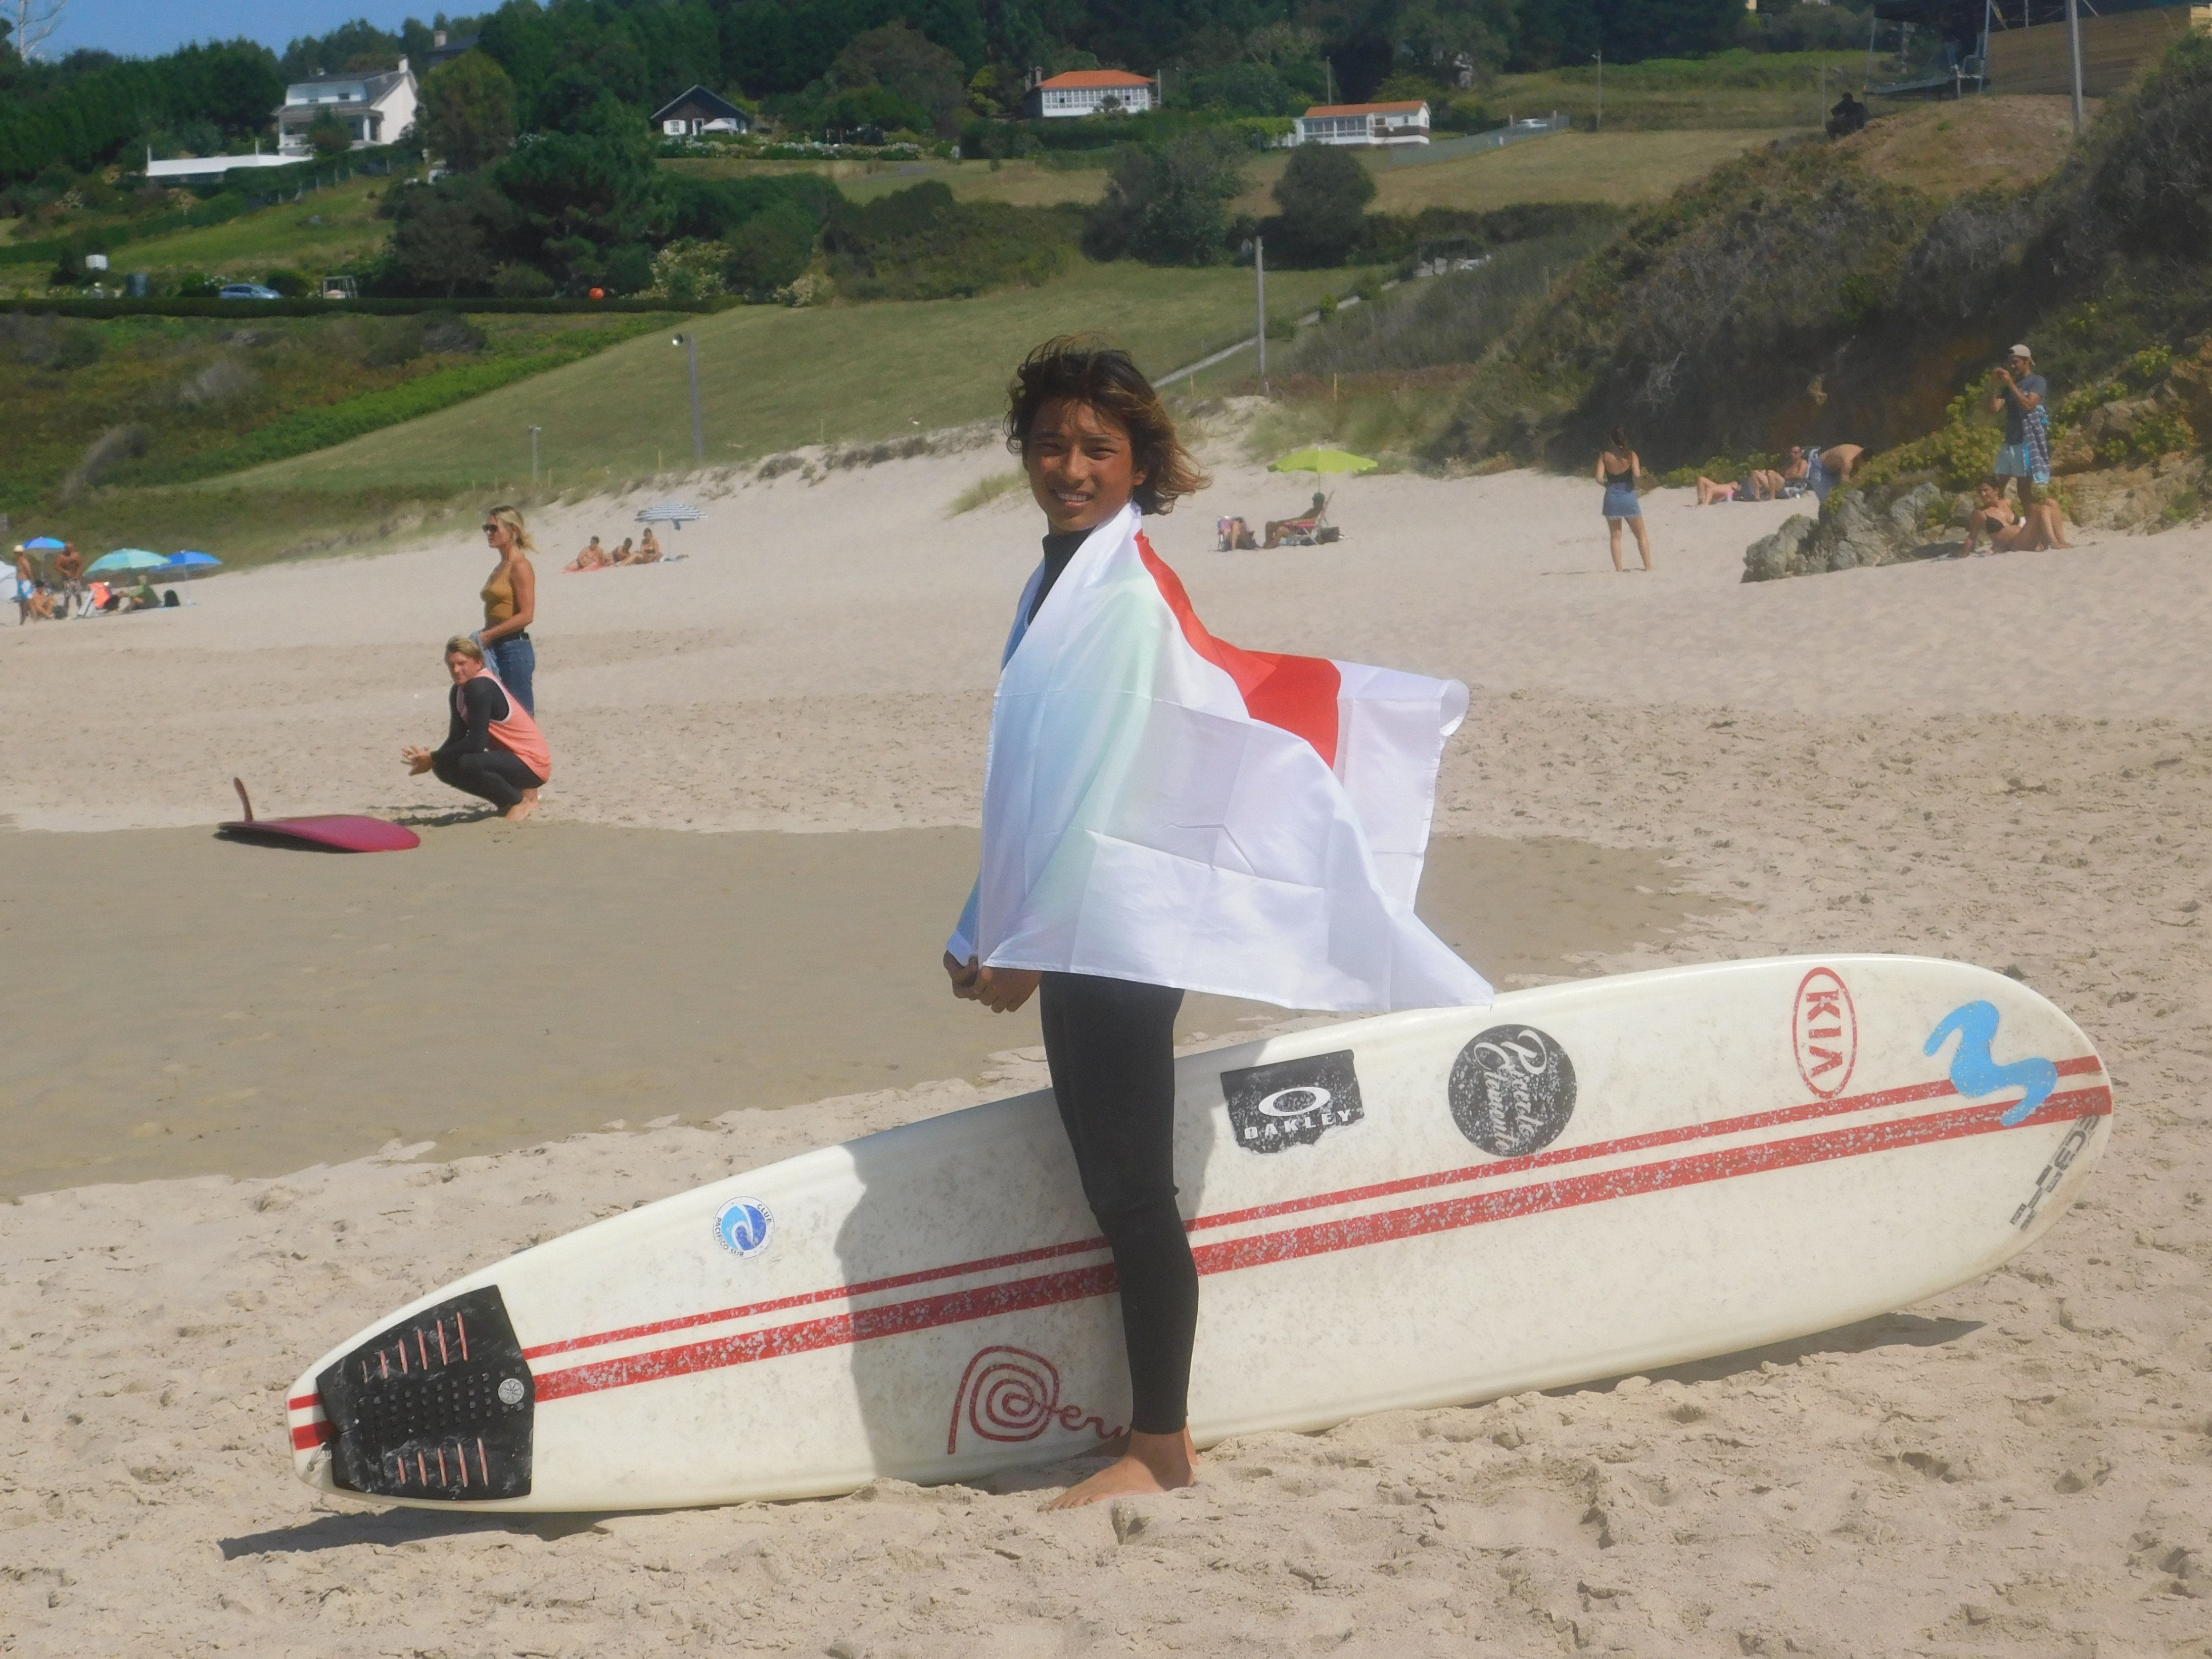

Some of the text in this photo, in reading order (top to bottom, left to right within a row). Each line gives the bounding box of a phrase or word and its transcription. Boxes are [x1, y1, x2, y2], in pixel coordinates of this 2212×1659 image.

[1806, 988, 1843, 1078] KIA
[1244, 1110, 1351, 1140] OAKLEY
[1474, 1041, 1518, 1151] Clemente
[715, 1217, 729, 1251] PACIFCO
[947, 1345, 1123, 1455] Per
